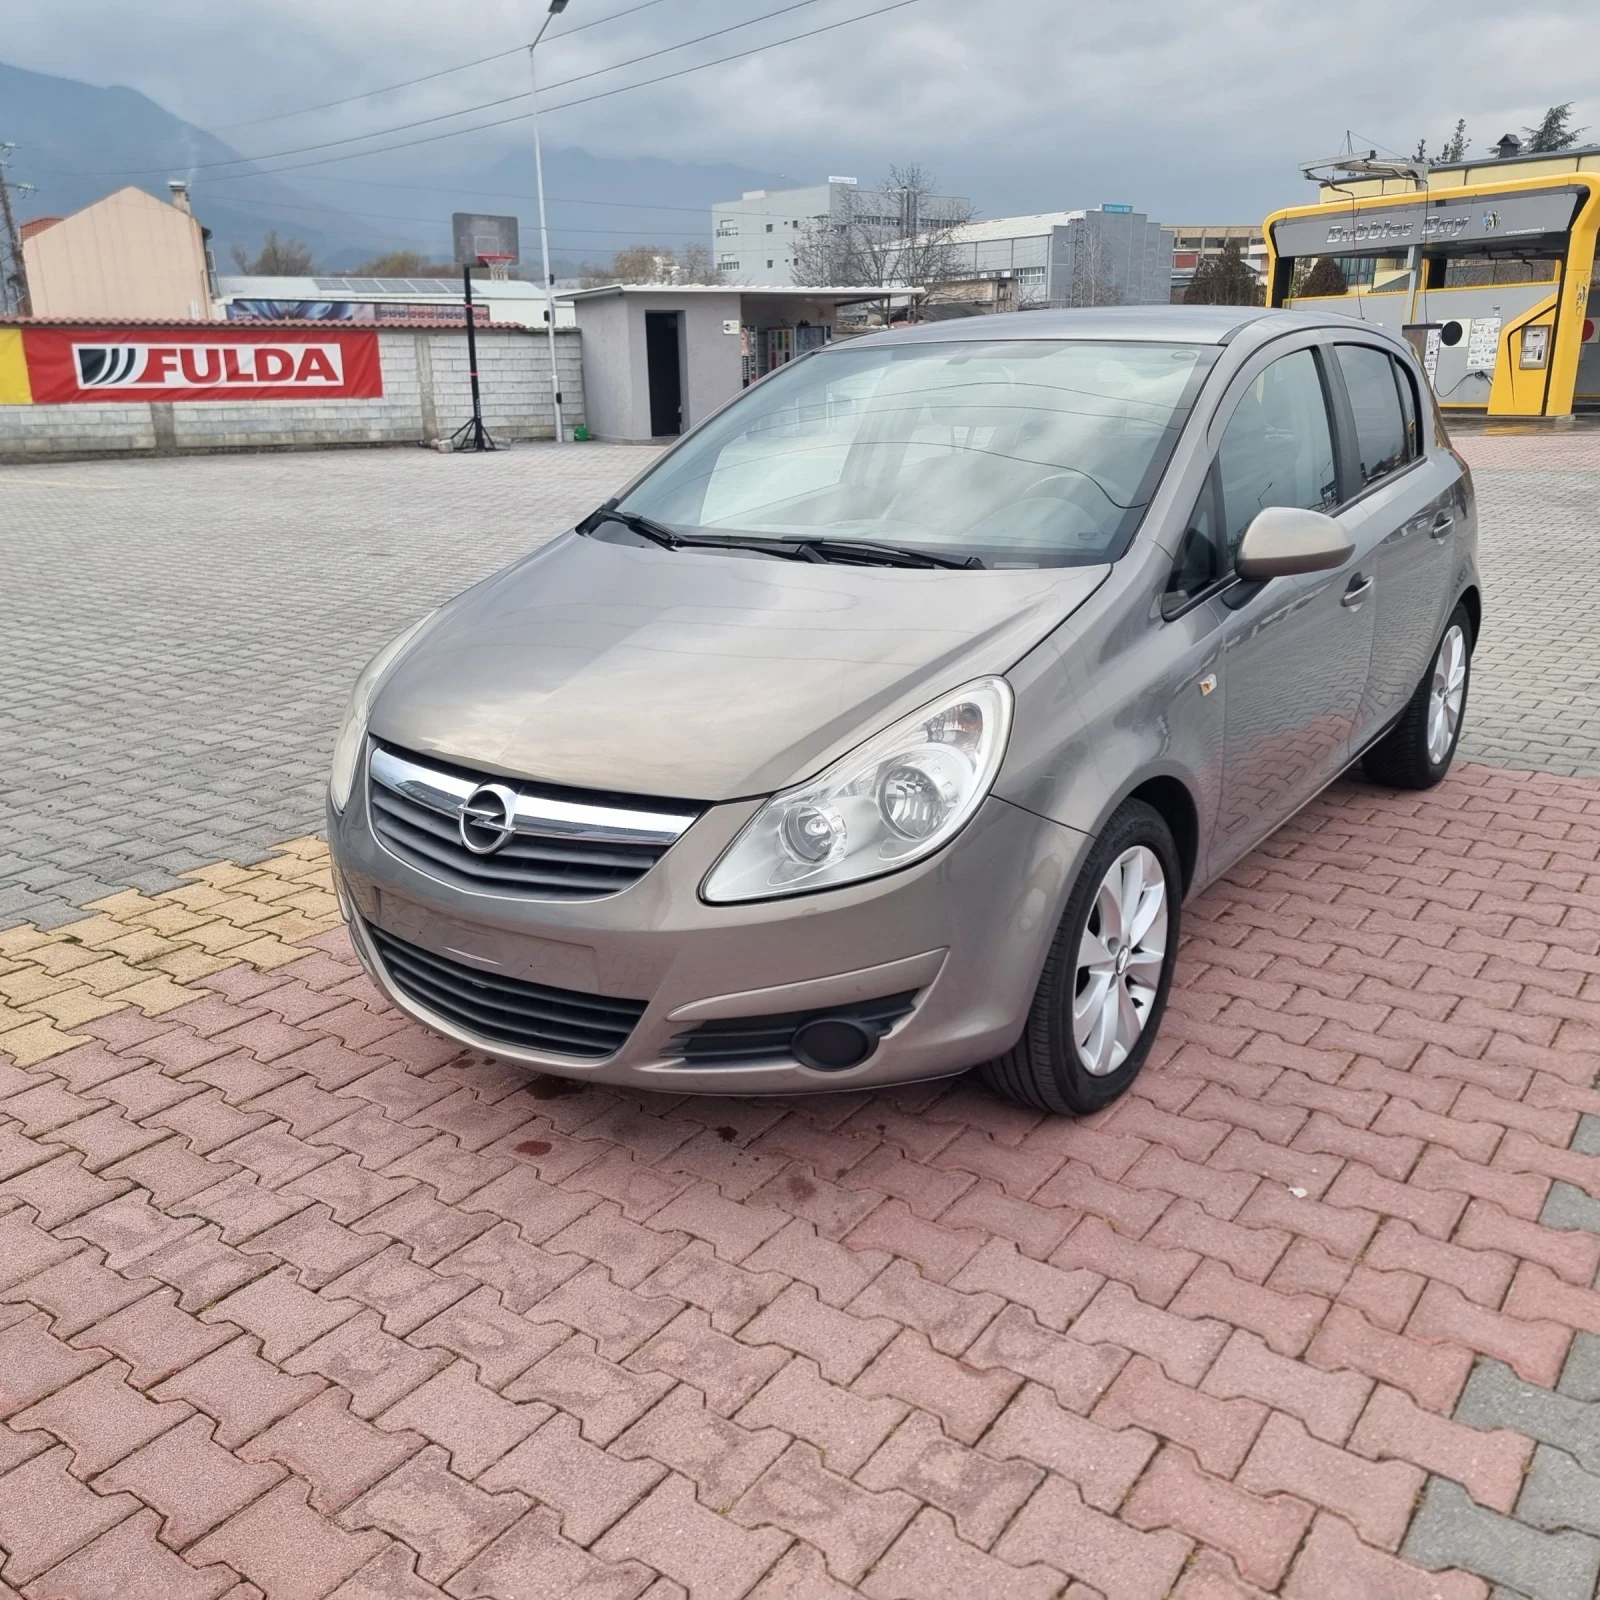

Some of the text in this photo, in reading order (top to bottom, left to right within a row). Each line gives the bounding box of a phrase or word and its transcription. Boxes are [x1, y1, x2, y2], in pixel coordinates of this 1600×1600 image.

[1326, 215, 1471, 244] Bubbles Bay
[131, 347, 340, 384] FULDA
